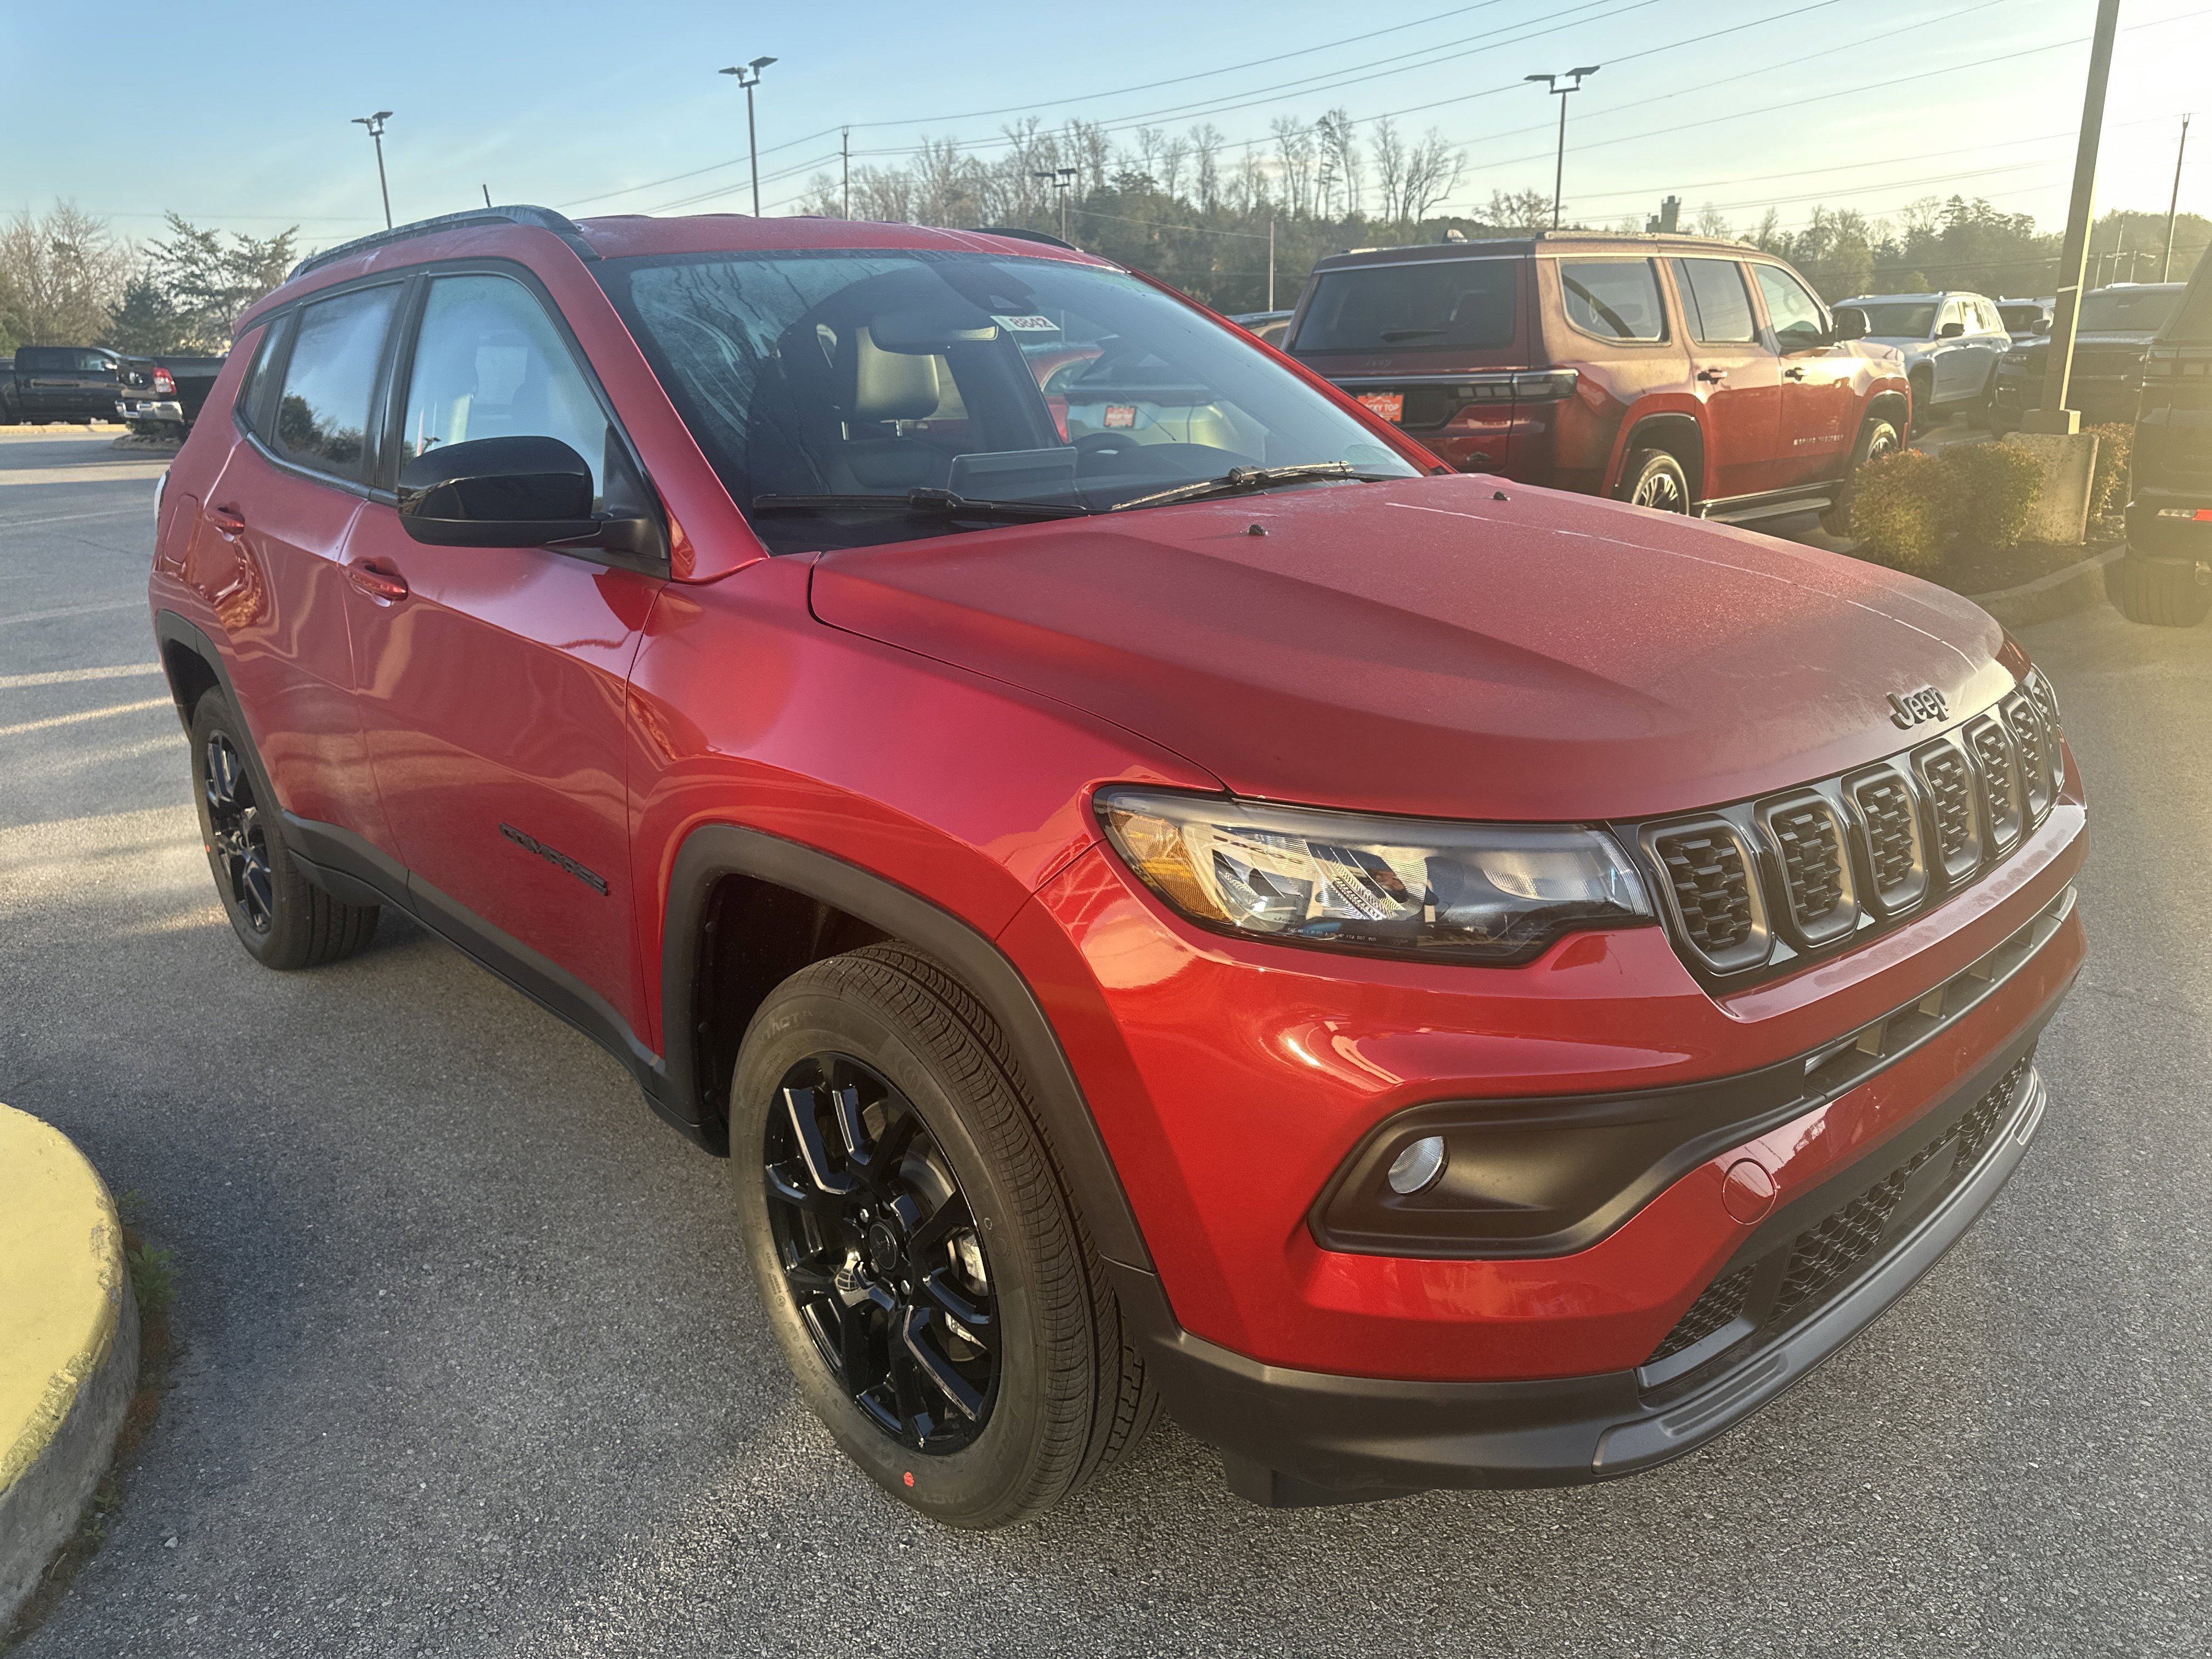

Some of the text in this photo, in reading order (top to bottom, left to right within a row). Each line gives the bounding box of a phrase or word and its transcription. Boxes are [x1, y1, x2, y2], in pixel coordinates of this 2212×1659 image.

[1009, 318, 1053, 328] 8842
[1886, 687, 1949, 730] Jeep
[499, 822, 608, 896] COMPASS
